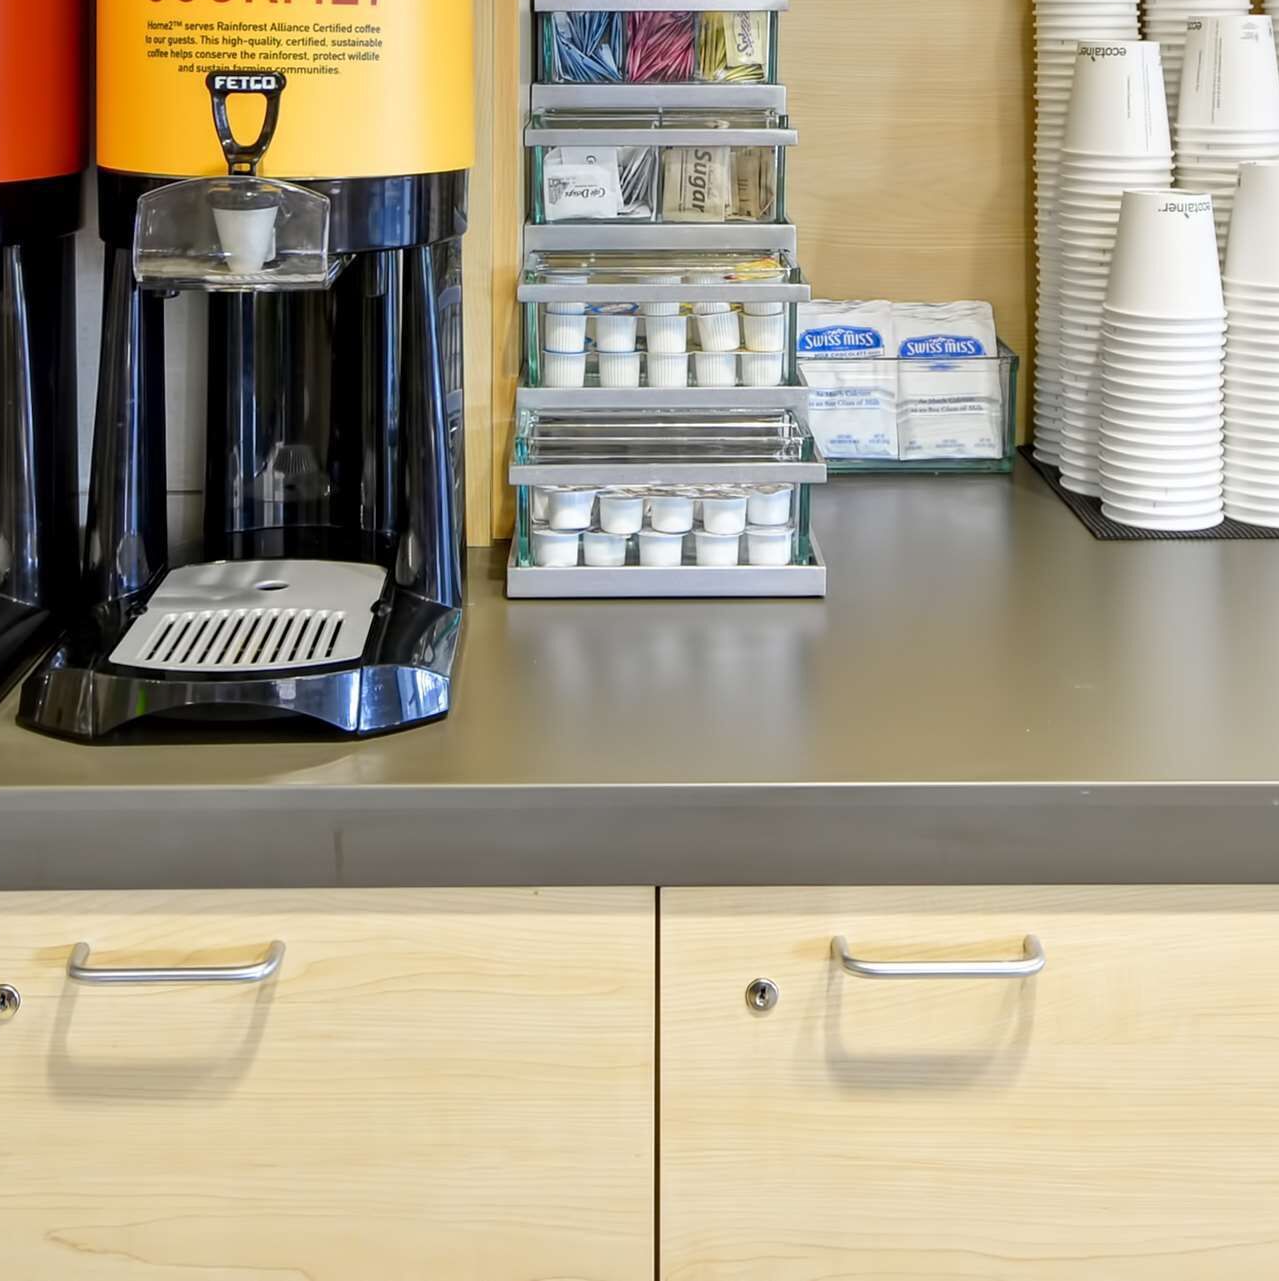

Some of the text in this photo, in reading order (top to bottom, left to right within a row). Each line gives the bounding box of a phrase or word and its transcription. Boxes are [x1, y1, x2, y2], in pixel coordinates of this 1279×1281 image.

[184, 23, 214, 31] serves
[217, 21, 267, 31] Rainforest
[270, 23, 310, 32] Alliance
[313, 23, 352, 33] Certified
[354, 24, 381, 34] coffee
[200, 35, 220, 45] This
[331, 38, 383, 48] sustainable
[147, 48, 168, 58] coffee
[170, 49, 193, 60] helps
[195, 51, 237, 59] conserve
[240, 50, 256, 59] the
[313, 51, 346, 62] protect
[348, 51, 380, 61] wildlife
[178, 63, 194, 73] and
[196, 64, 230, 73] sustain
[214, 76, 276, 89] FETCO
[689, 149, 711, 213] Sugar
